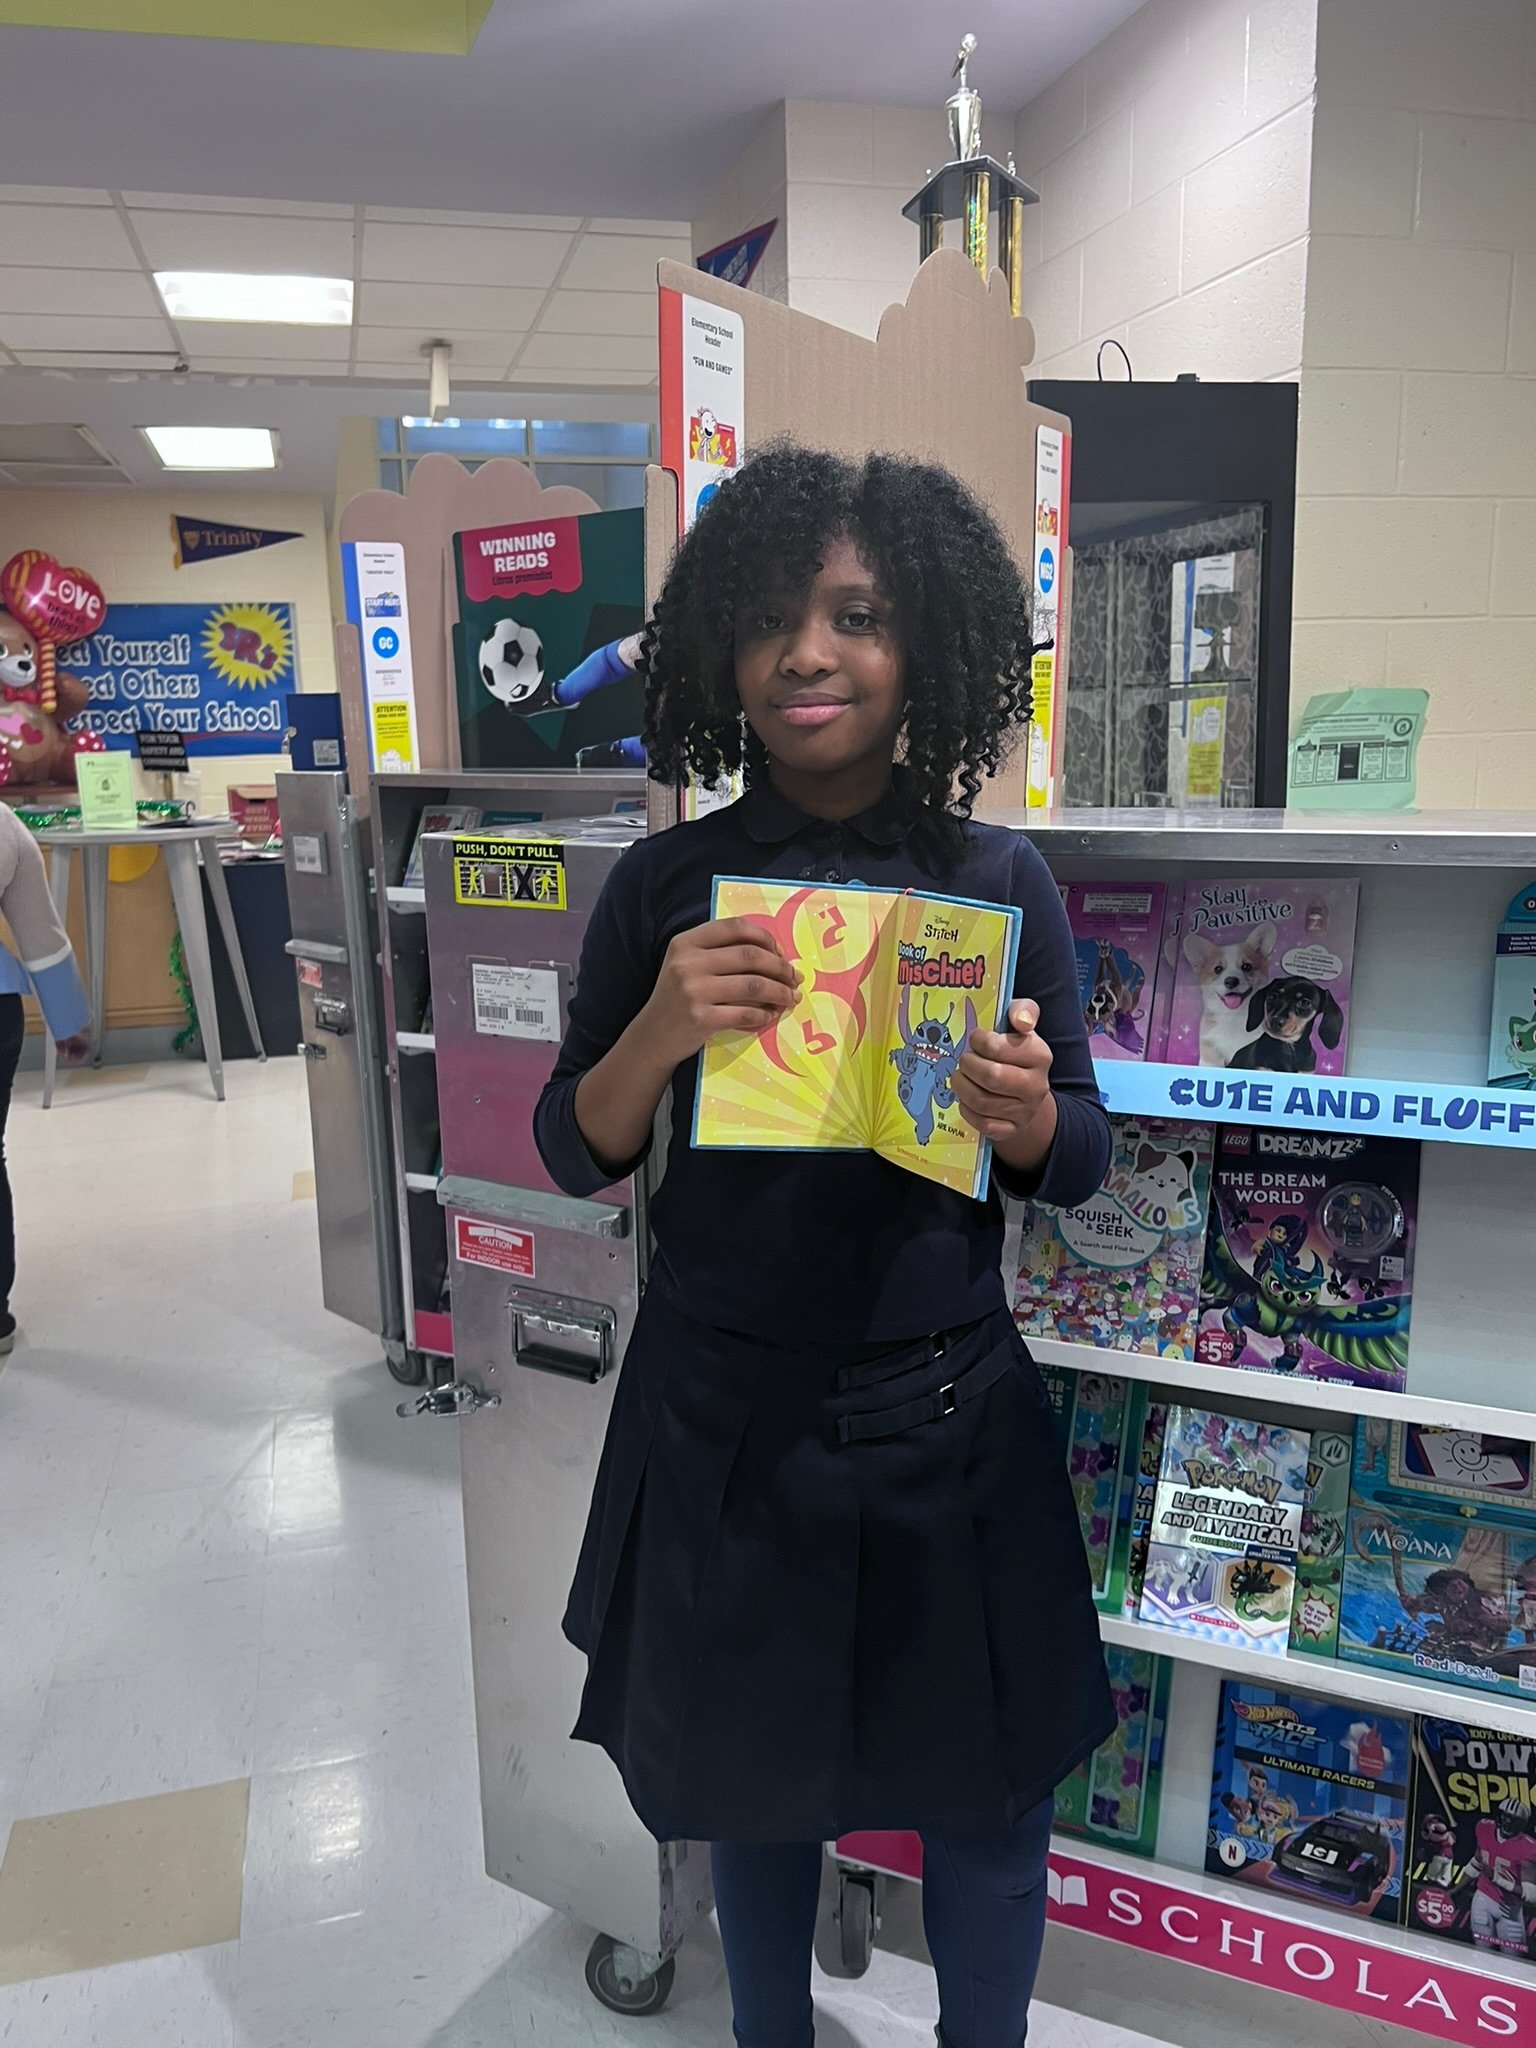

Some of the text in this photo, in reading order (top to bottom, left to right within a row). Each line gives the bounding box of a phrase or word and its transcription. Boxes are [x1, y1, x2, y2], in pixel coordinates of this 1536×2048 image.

[691, 317, 734, 339] Elementary School
[705, 359, 715, 370] AND
[201, 530, 263, 548] Trinity
[480, 532, 556, 557] WINNING
[494, 551, 549, 573] READS
[95, 634, 190, 666] Yourself
[120, 668, 200, 700] Others
[65, 700, 281, 734] espect Your School
[455, 844, 559, 859] PUSH, DON'T PULL.
[1201, 886, 1247, 909] Stay
[1190, 899, 1292, 932] Pawsitive
[1169, 1078, 1536, 1133] CUTE AND FLUFF
[1223, 1134, 1249, 1147] LEGO
[1219, 1173, 1327, 1188] THE DREAM
[1235, 1190, 1305, 1205] WORLD
[1064, 1207, 1123, 1226] SQUISH
[1086, 1222, 1134, 1240] & SEEK
[479, 1236, 512, 1251] CAUTION
[1172, 1491, 1288, 1526] LEGENDARY
[1161, 1512, 1293, 1547] AND MYTHICAL
[1190, 1534, 1246, 1552] GUIDEBOOK
[1414, 1653, 1450, 1672] Read
[1455, 1661, 1500, 1683] Doodle
[1249, 1723, 1326, 1749] RACE
[1263, 1755, 1376, 1790] ULTIMATE RACERS
[1107, 1888, 1518, 2035] SCHOLAS
